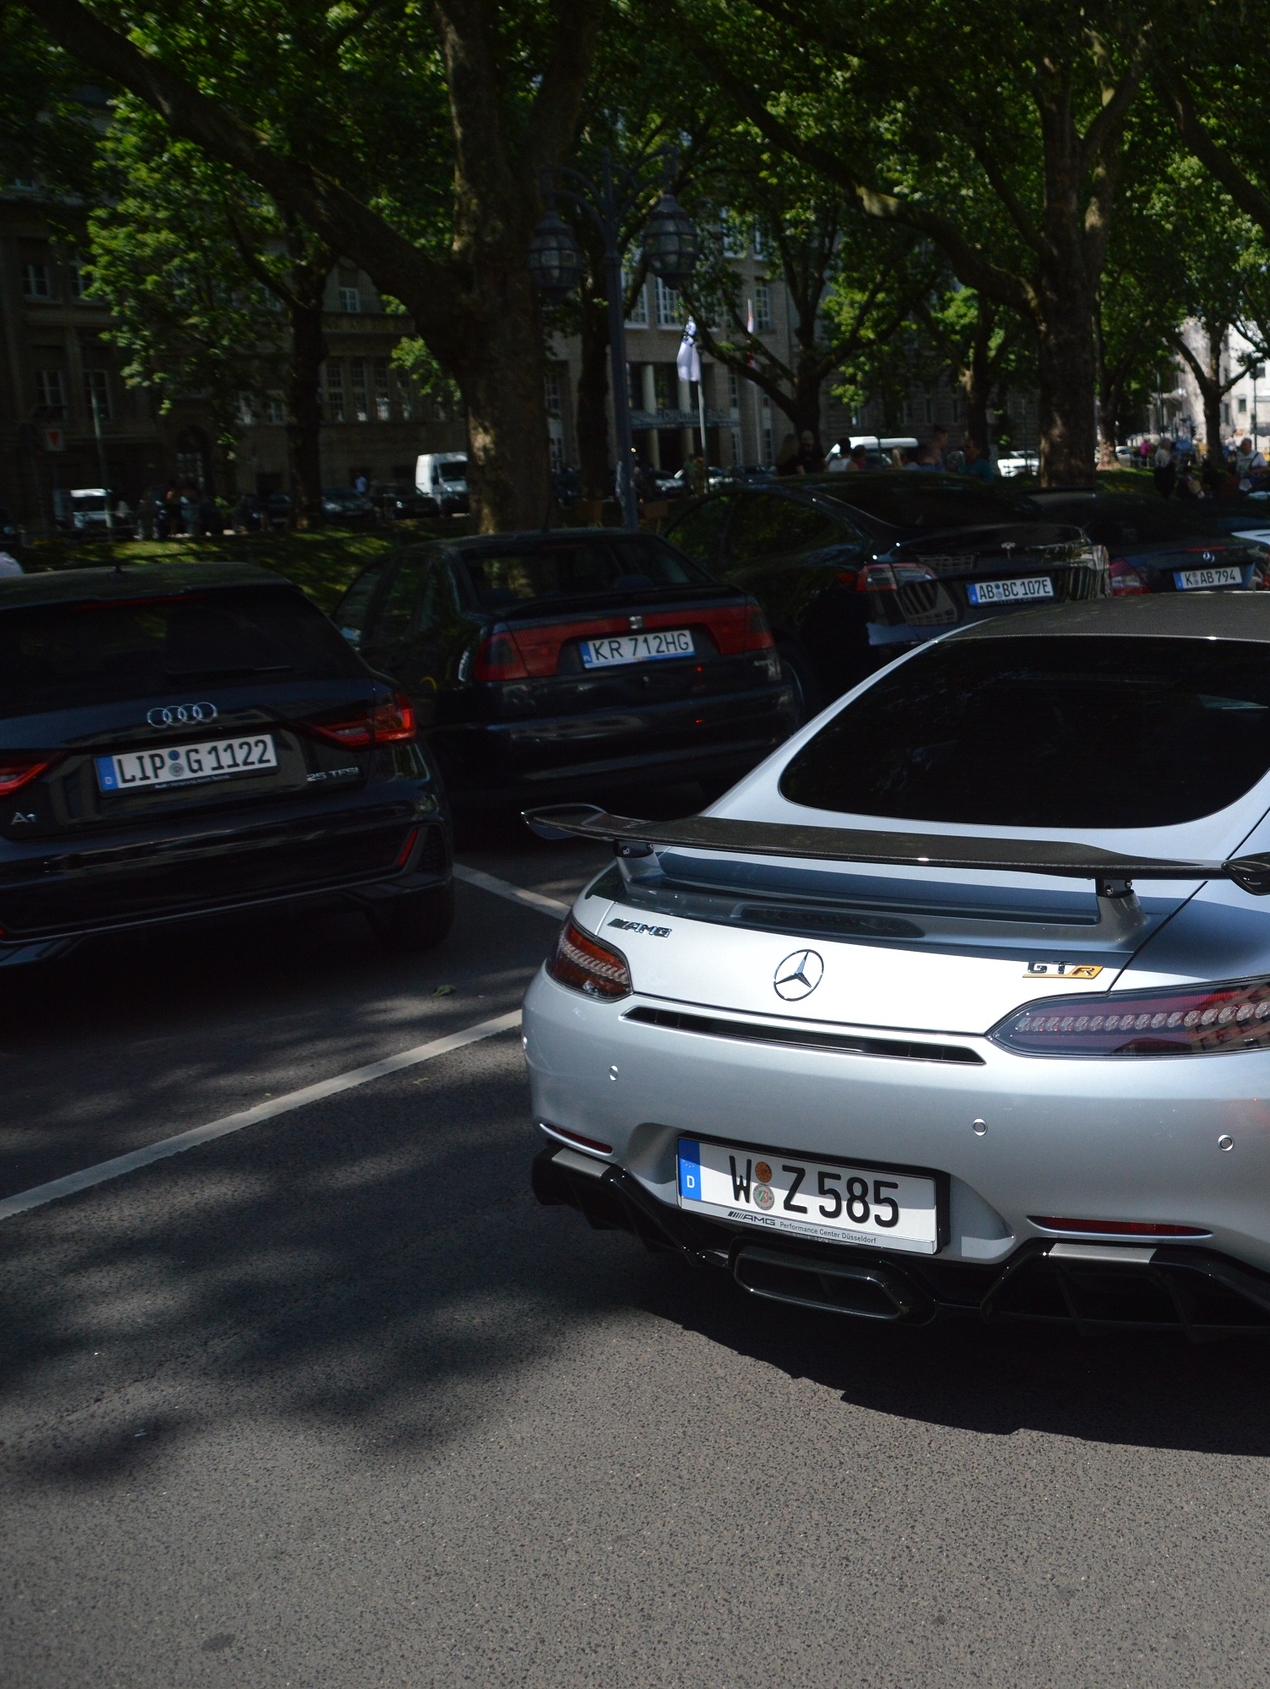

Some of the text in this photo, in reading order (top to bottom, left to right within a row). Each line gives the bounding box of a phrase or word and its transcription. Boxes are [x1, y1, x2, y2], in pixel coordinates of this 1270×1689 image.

[1185, 569, 1236, 586] K AB 794
[979, 579, 1051, 600] AB BC 107E
[592, 633, 690, 661] KR 712HG
[116, 739, 272, 784] LIP G 1122
[306, 766, 360, 782] 25 TFSI
[10, 811, 37, 826] A1
[686, 1174, 696, 1189] D
[728, 1155, 900, 1228] W Z 585
[744, 1215, 877, 1245] AMG Performance Center Düsseldorf
